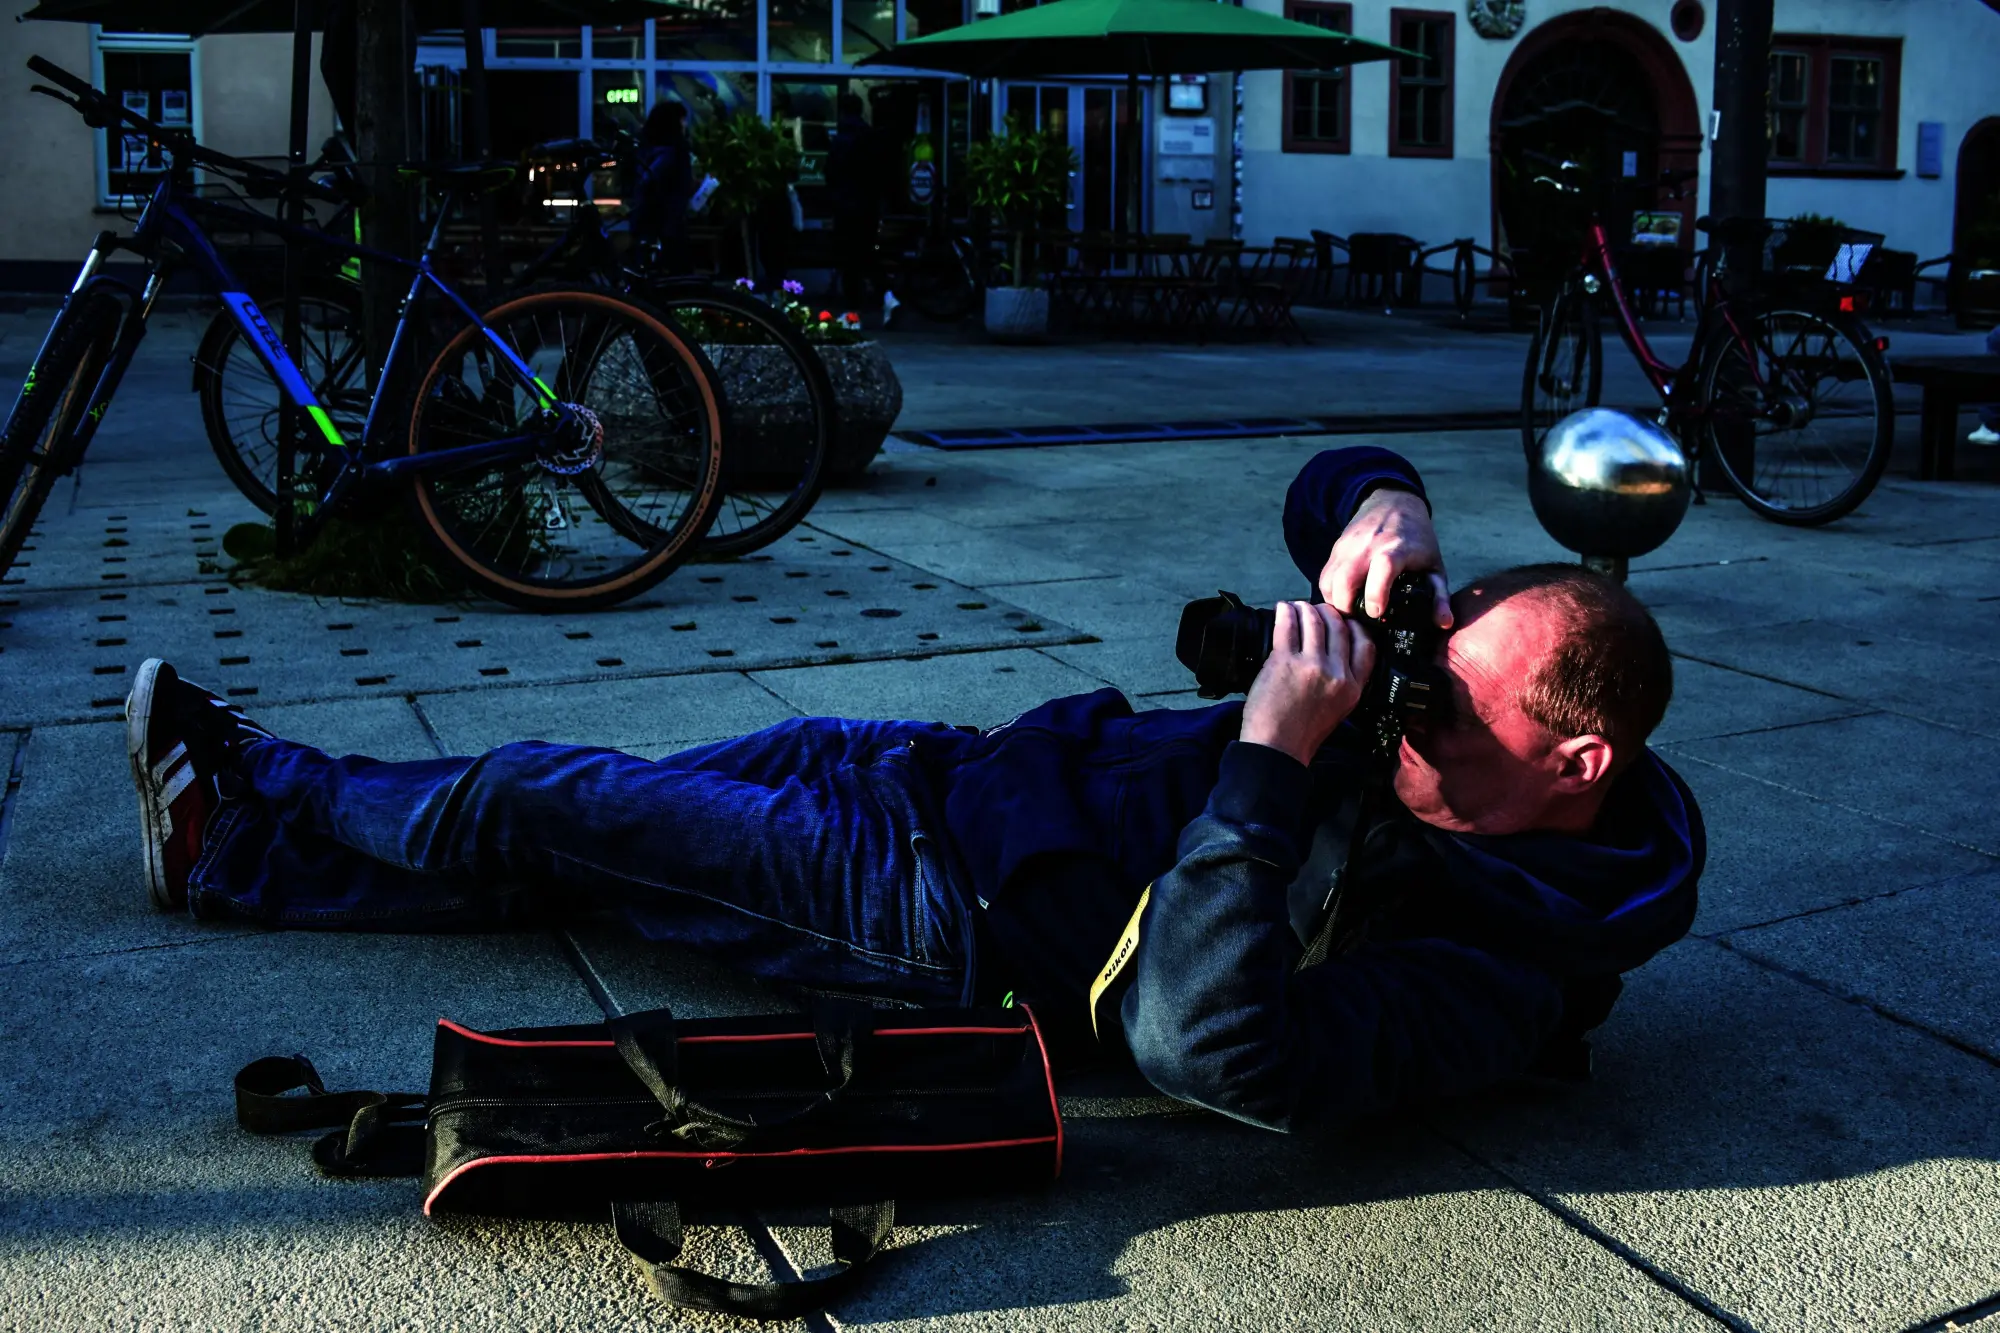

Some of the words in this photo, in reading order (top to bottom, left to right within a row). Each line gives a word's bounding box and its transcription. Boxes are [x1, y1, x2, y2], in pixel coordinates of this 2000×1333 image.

[606, 89, 639, 103] OPEN
[243, 301, 285, 360] CUBE
[1388, 675, 1401, 704] Nikon
[1104, 937, 1132, 981] Nikon
